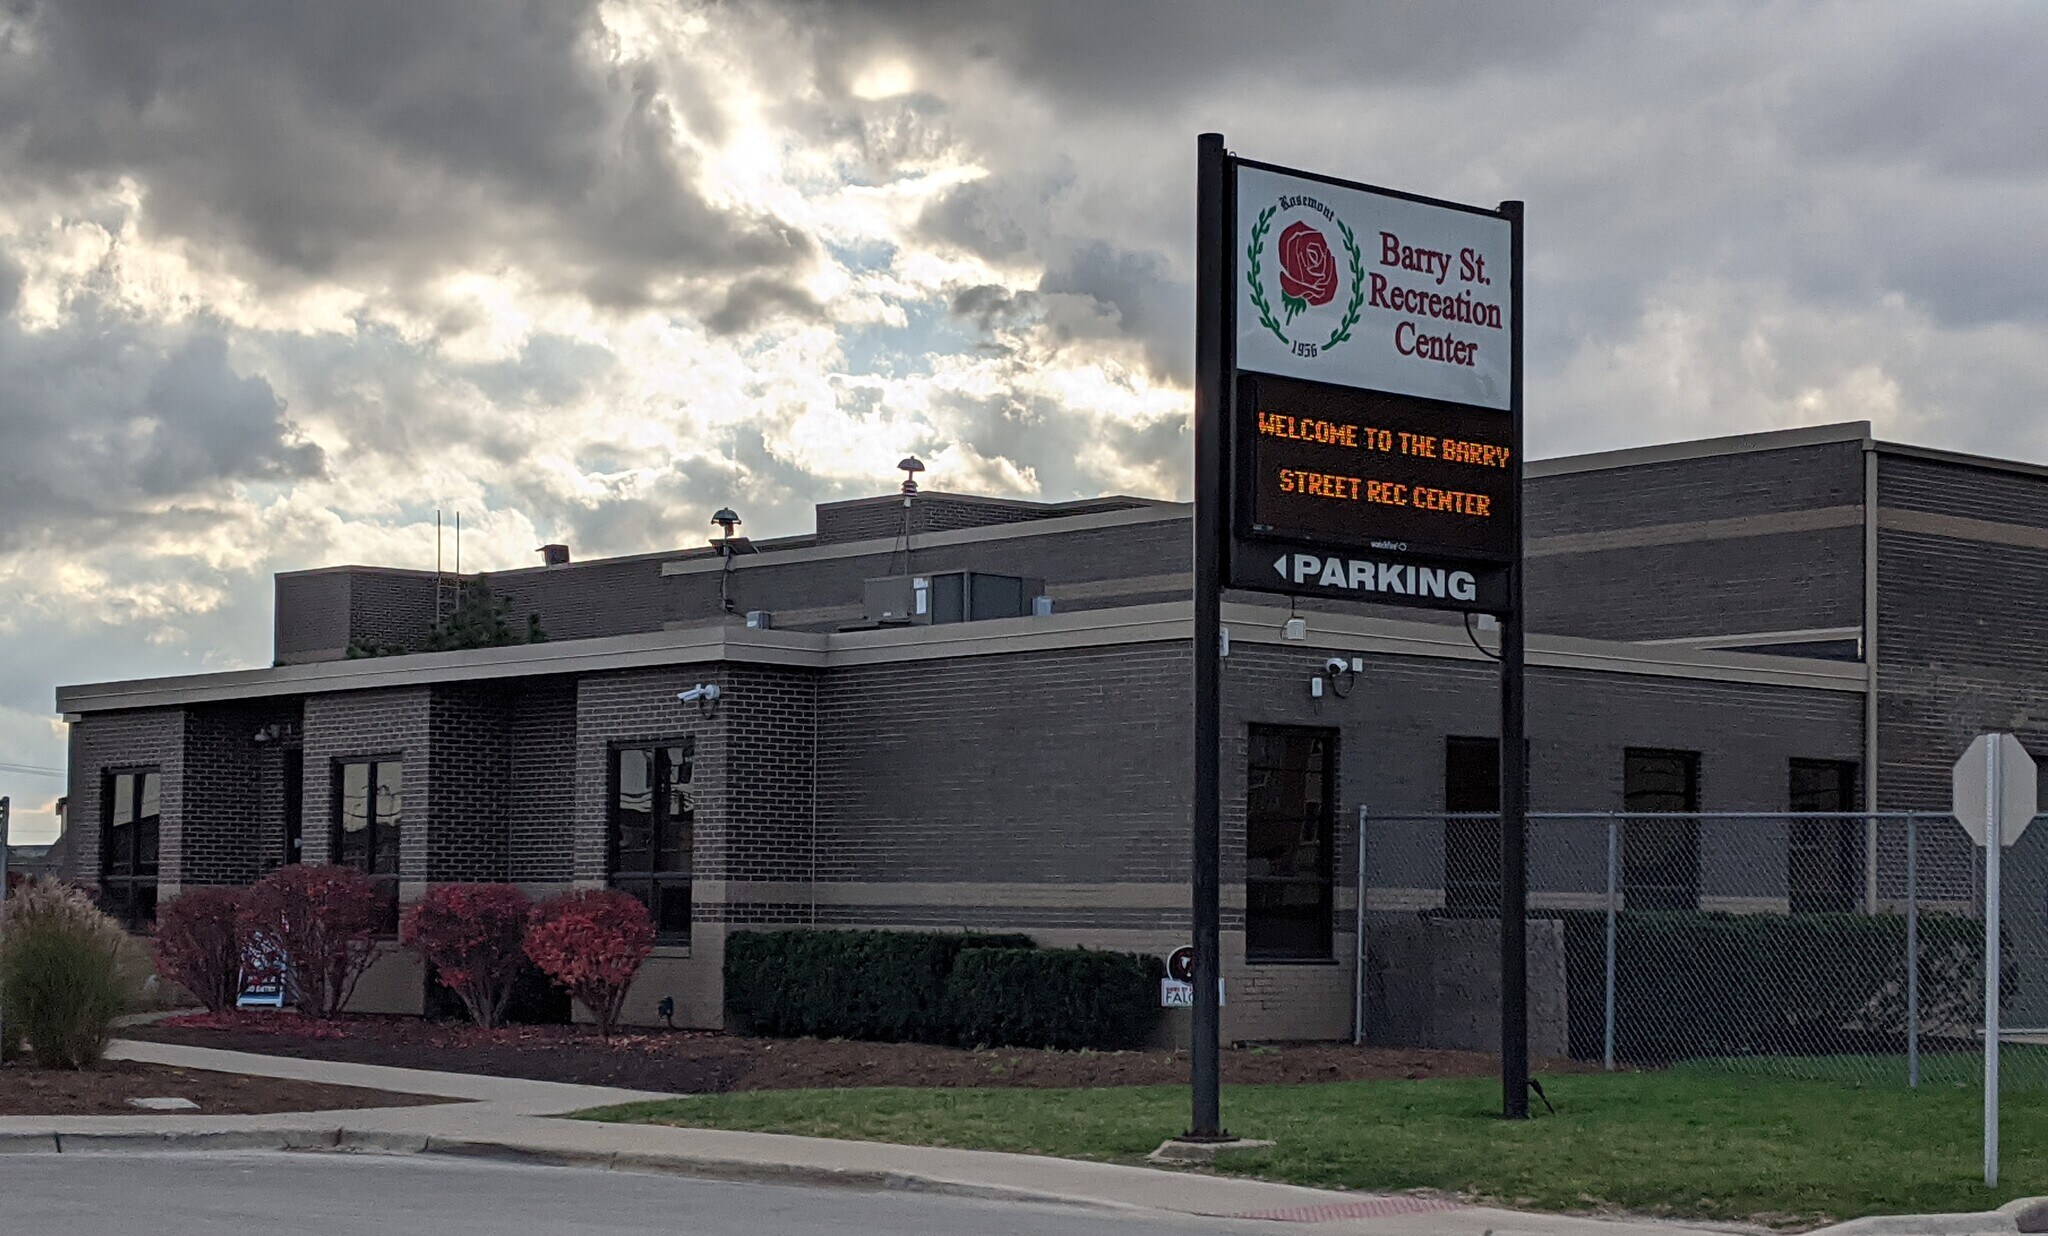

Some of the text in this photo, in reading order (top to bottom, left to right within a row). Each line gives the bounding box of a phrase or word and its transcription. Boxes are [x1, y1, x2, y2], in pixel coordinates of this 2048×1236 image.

[1279, 195, 1335, 222] Rosemont
[1379, 231, 1491, 285] Barry St.
[1368, 272, 1503, 329] Recreation
[1291, 340, 1318, 358] 1956
[1395, 321, 1478, 366] Center
[1258, 411, 1510, 468] WELCOME TO THE BARRY
[1279, 468, 1491, 517] STREET REC CENTER
[1293, 553, 1477, 601] PARKING
